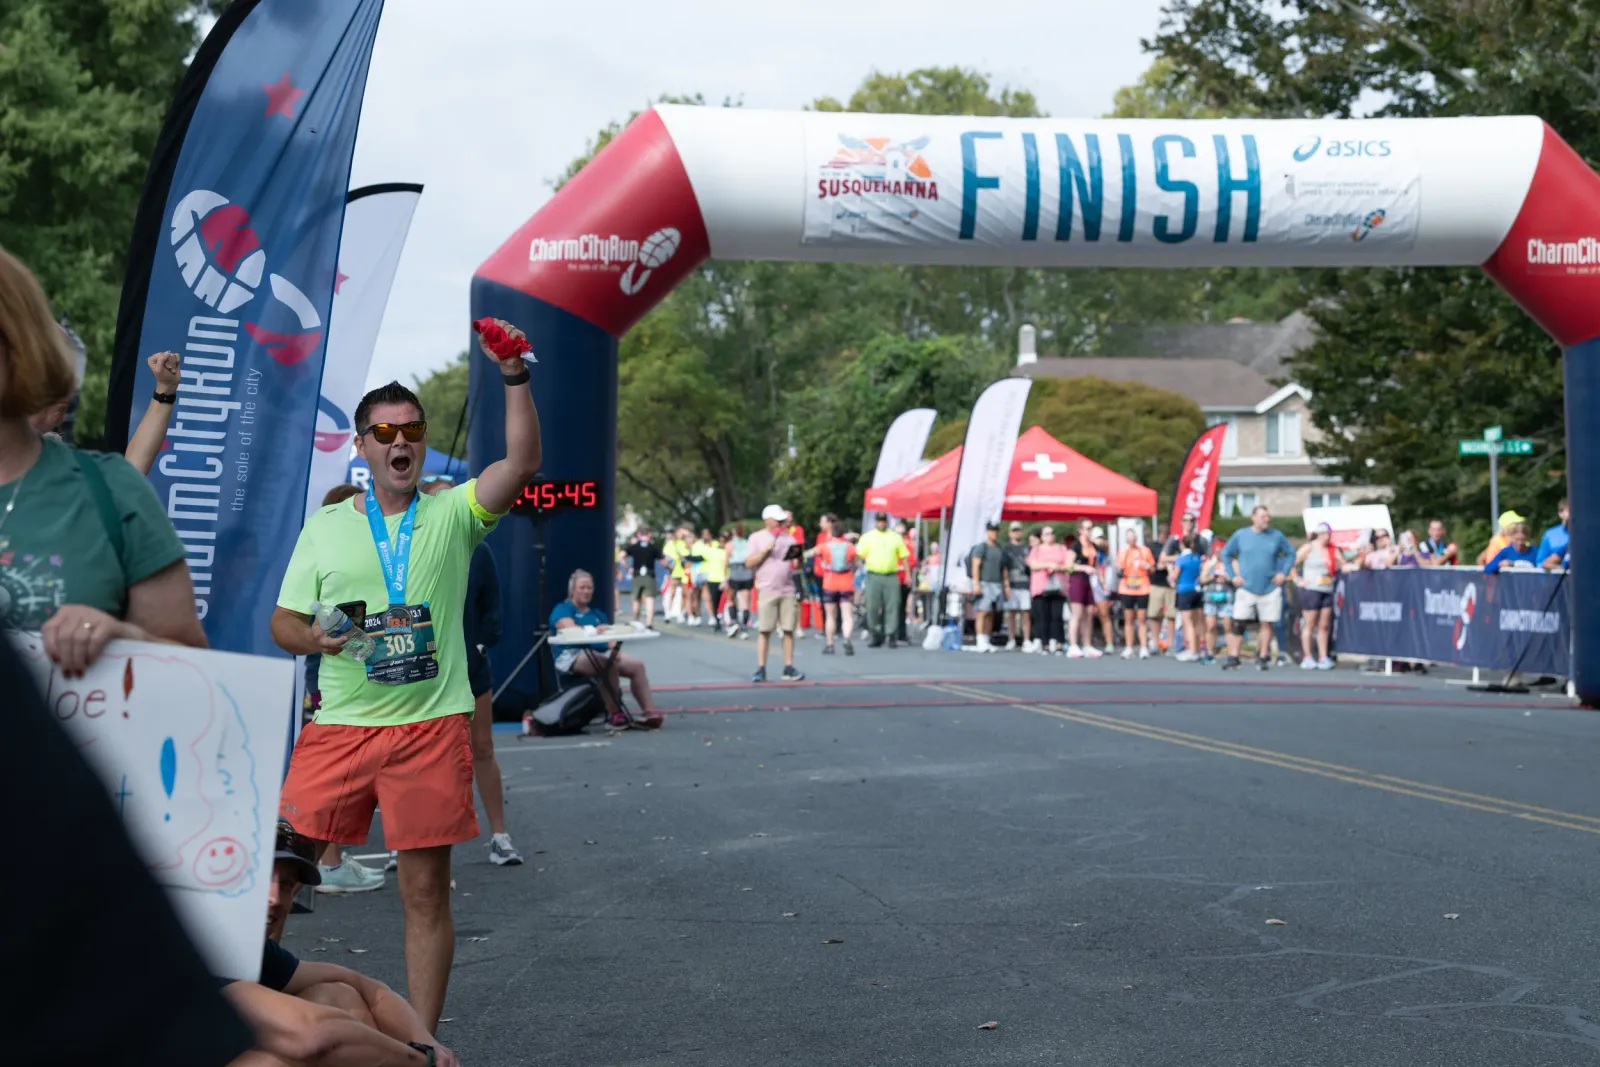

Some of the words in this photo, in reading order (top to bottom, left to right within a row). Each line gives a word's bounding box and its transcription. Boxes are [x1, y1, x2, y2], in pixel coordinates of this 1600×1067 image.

[818, 179, 938, 200] SUSQUEHANNA
[958, 131, 1262, 243] FINISH
[529, 233, 639, 265] CharmCityRun
[1527, 236, 1600, 265] CharmCit
[245, 367, 263, 395] city
[240, 401, 256, 425] the
[238, 430, 252, 446] of
[235, 452, 250, 482] sole
[230, 488, 246, 511] the
[365, 618, 381, 628] 2024
[384, 634, 415, 657] 303
